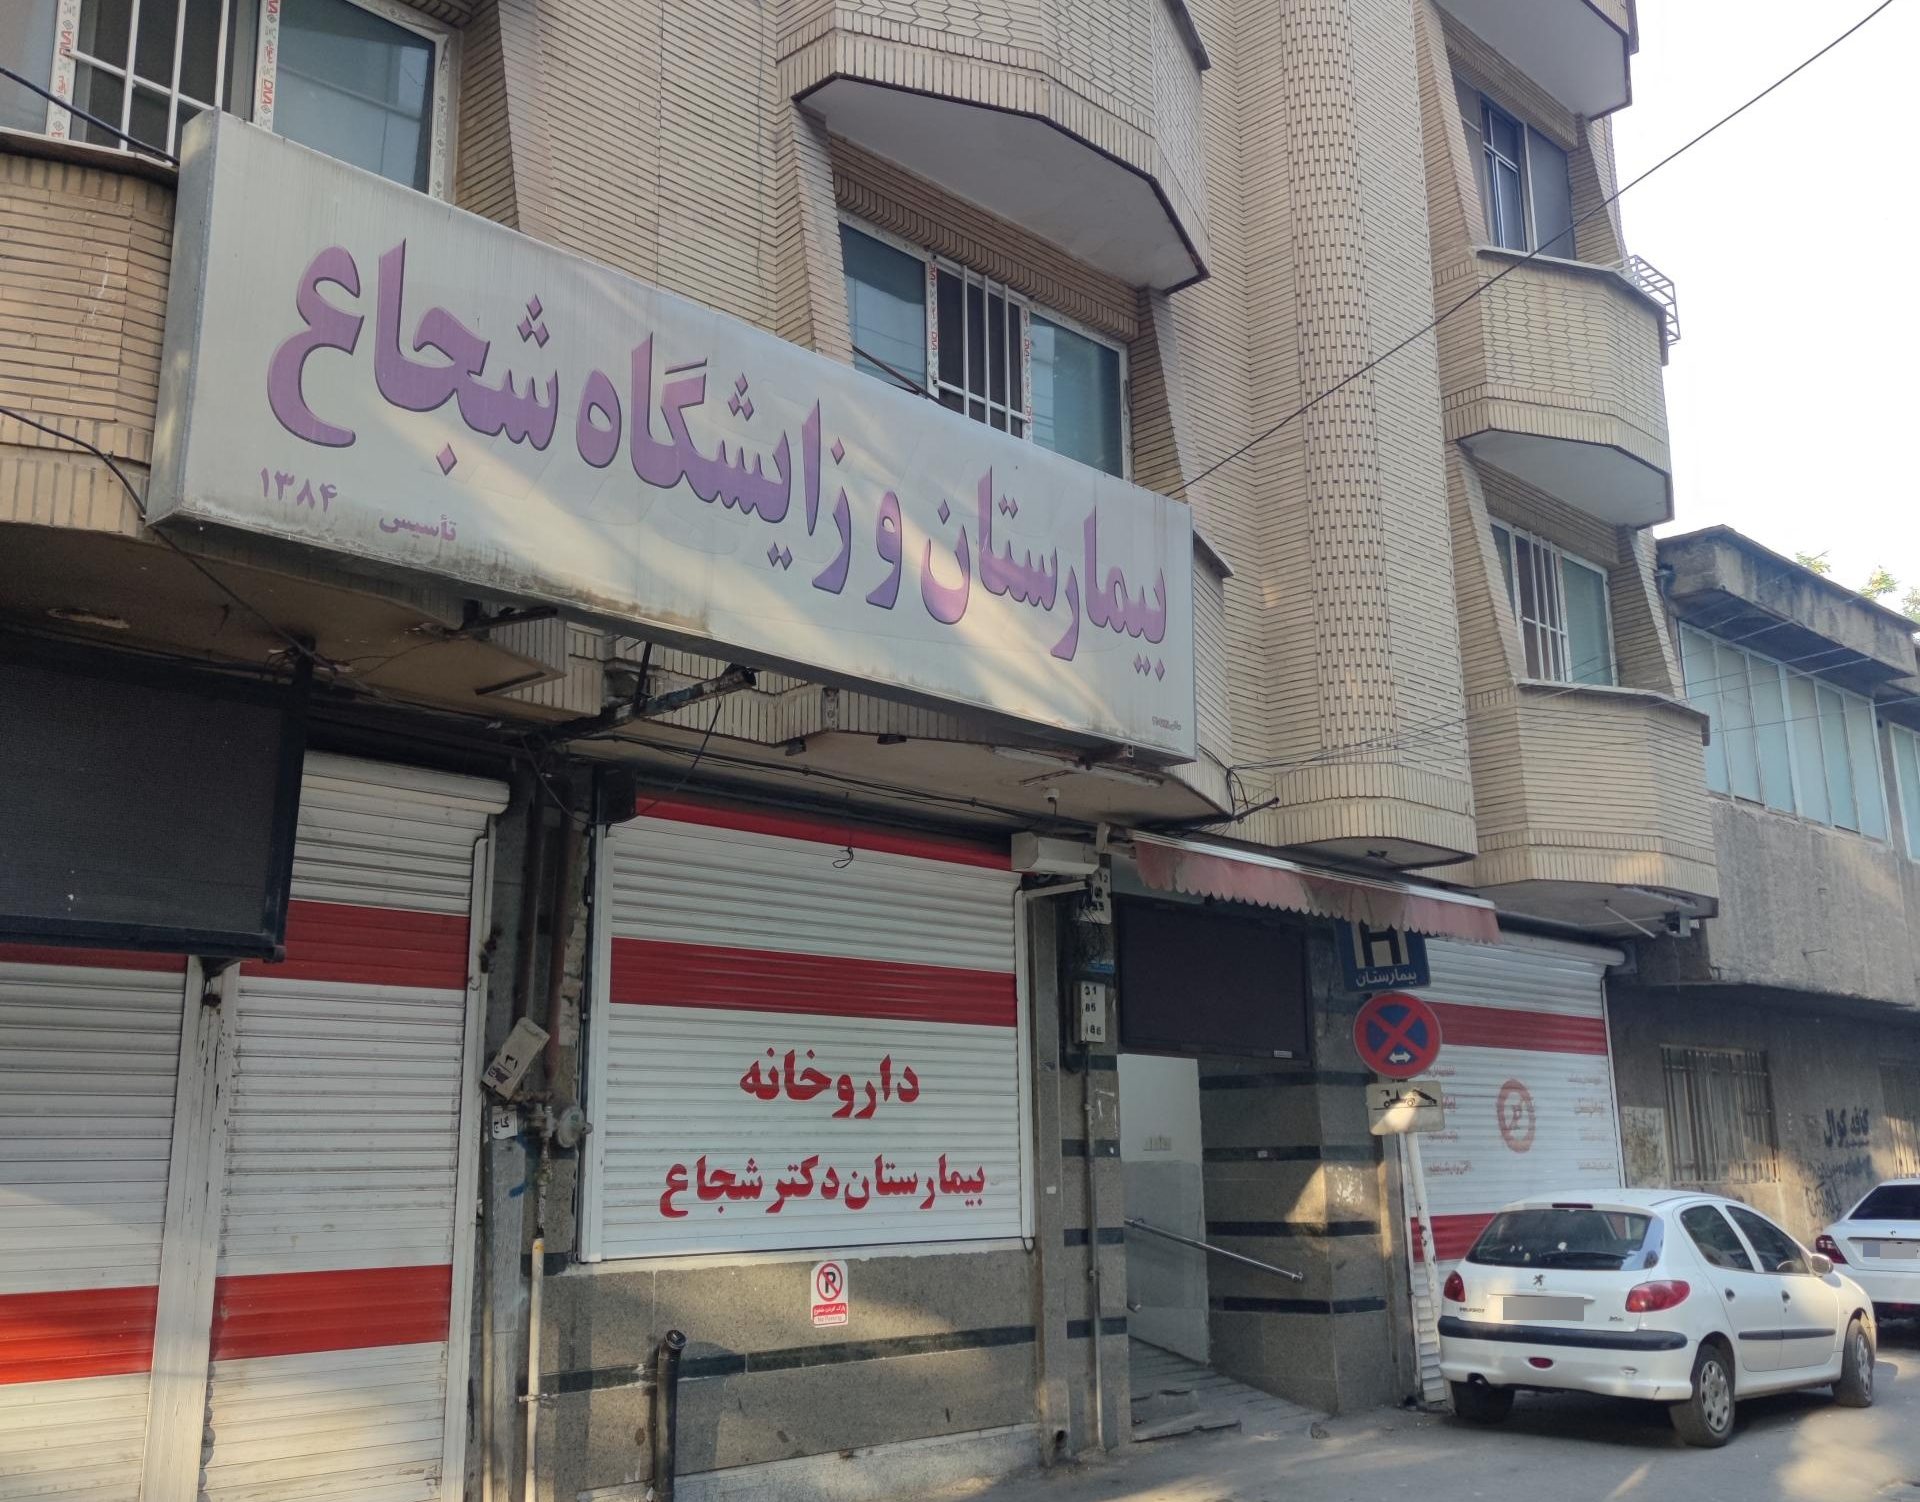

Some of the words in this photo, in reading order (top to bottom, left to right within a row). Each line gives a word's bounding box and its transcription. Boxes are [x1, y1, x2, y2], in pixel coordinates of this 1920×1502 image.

[267, 237, 560, 476] شجاع
[260, 467, 338, 513] ۱۳۸۴
[575, 331, 851, 596] زایشگاه
[379, 514, 457, 541] تأسیس
[866, 490, 904, 609] و
[920, 466, 1168, 682] بیمارستان
[1356, 968, 1417, 988] بیمارستان
[740, 1047, 920, 1120] داروخانه
[658, 1154, 763, 1218] شجاع
[765, 1154, 839, 1214] دکتر
[844, 1153, 985, 1211] بیمارستان
